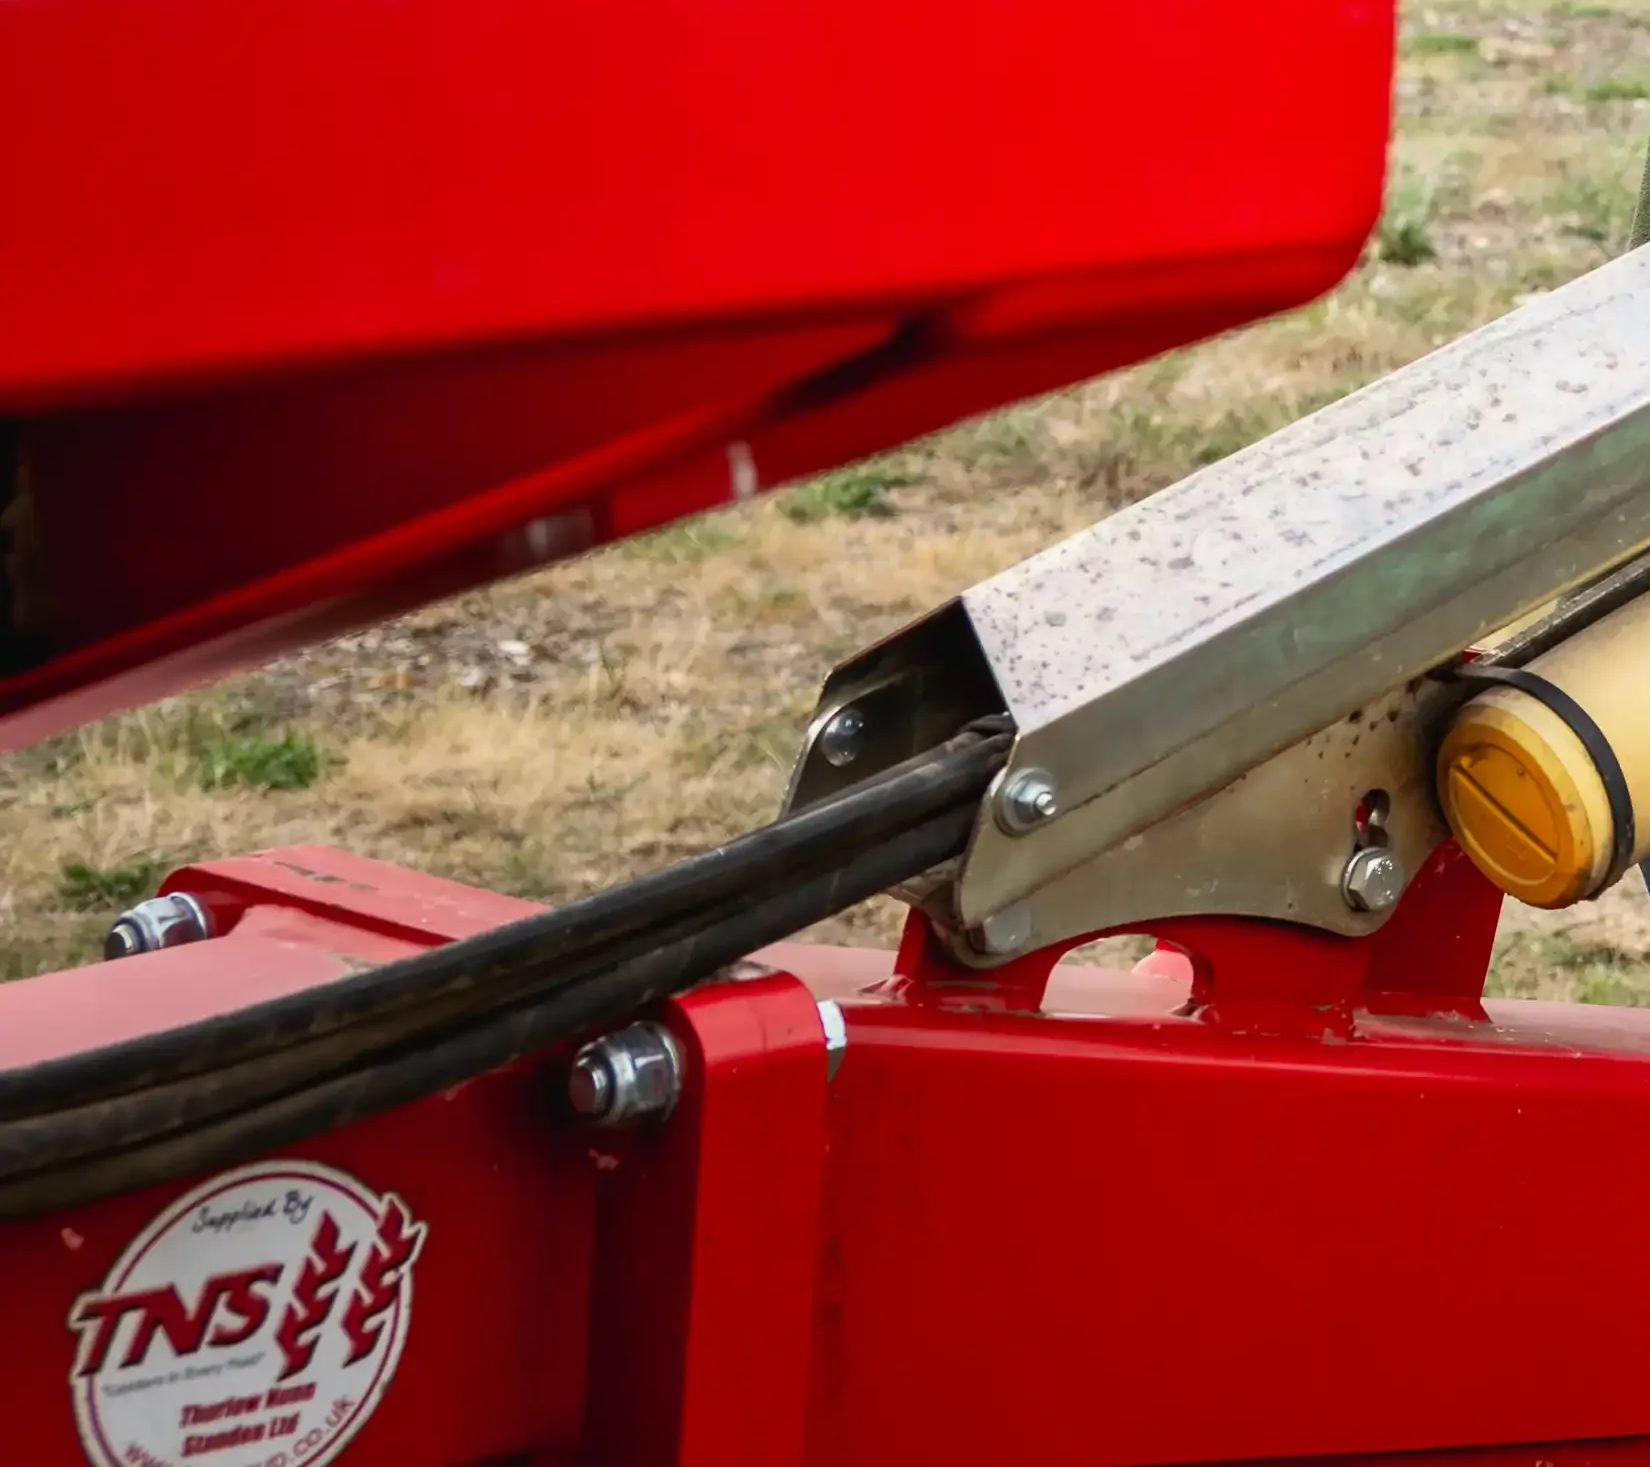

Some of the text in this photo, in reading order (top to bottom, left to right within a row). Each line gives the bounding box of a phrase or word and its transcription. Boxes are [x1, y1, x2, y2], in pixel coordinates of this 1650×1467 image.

[193, 1189, 313, 1235] Supplied By
[76, 1262, 285, 1379] TNS
[179, 1394, 263, 1429] Thurlow
[180, 1411, 302, 1458] Standen Ltd
